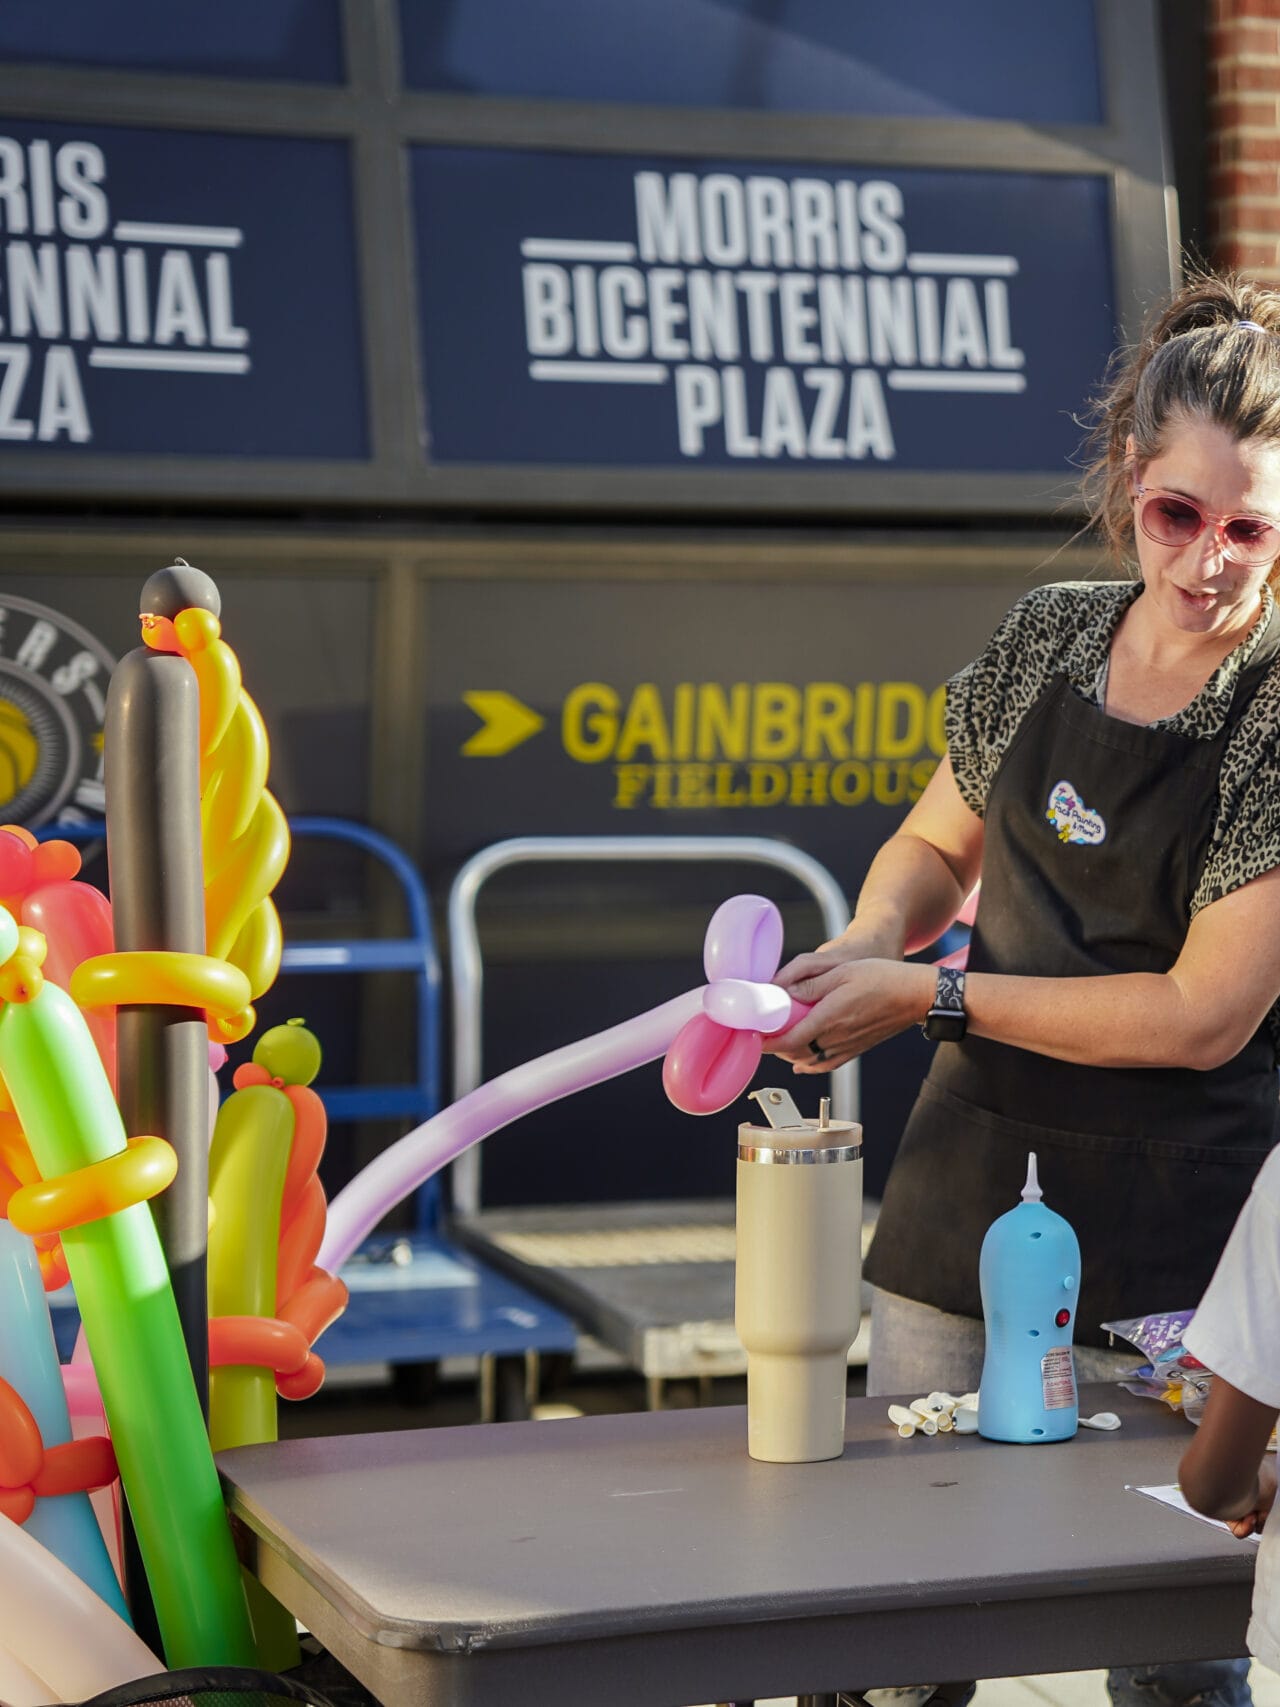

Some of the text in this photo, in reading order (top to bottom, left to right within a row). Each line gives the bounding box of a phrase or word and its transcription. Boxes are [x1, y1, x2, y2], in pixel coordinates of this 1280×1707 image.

[634, 170, 907, 271] MORRIS
[0, 240, 250, 348] NNIAL
[522, 262, 1025, 369] BICENTENNIAL
[674, 364, 897, 461] PLAZA
[1072, 810, 1102, 833] Painting
